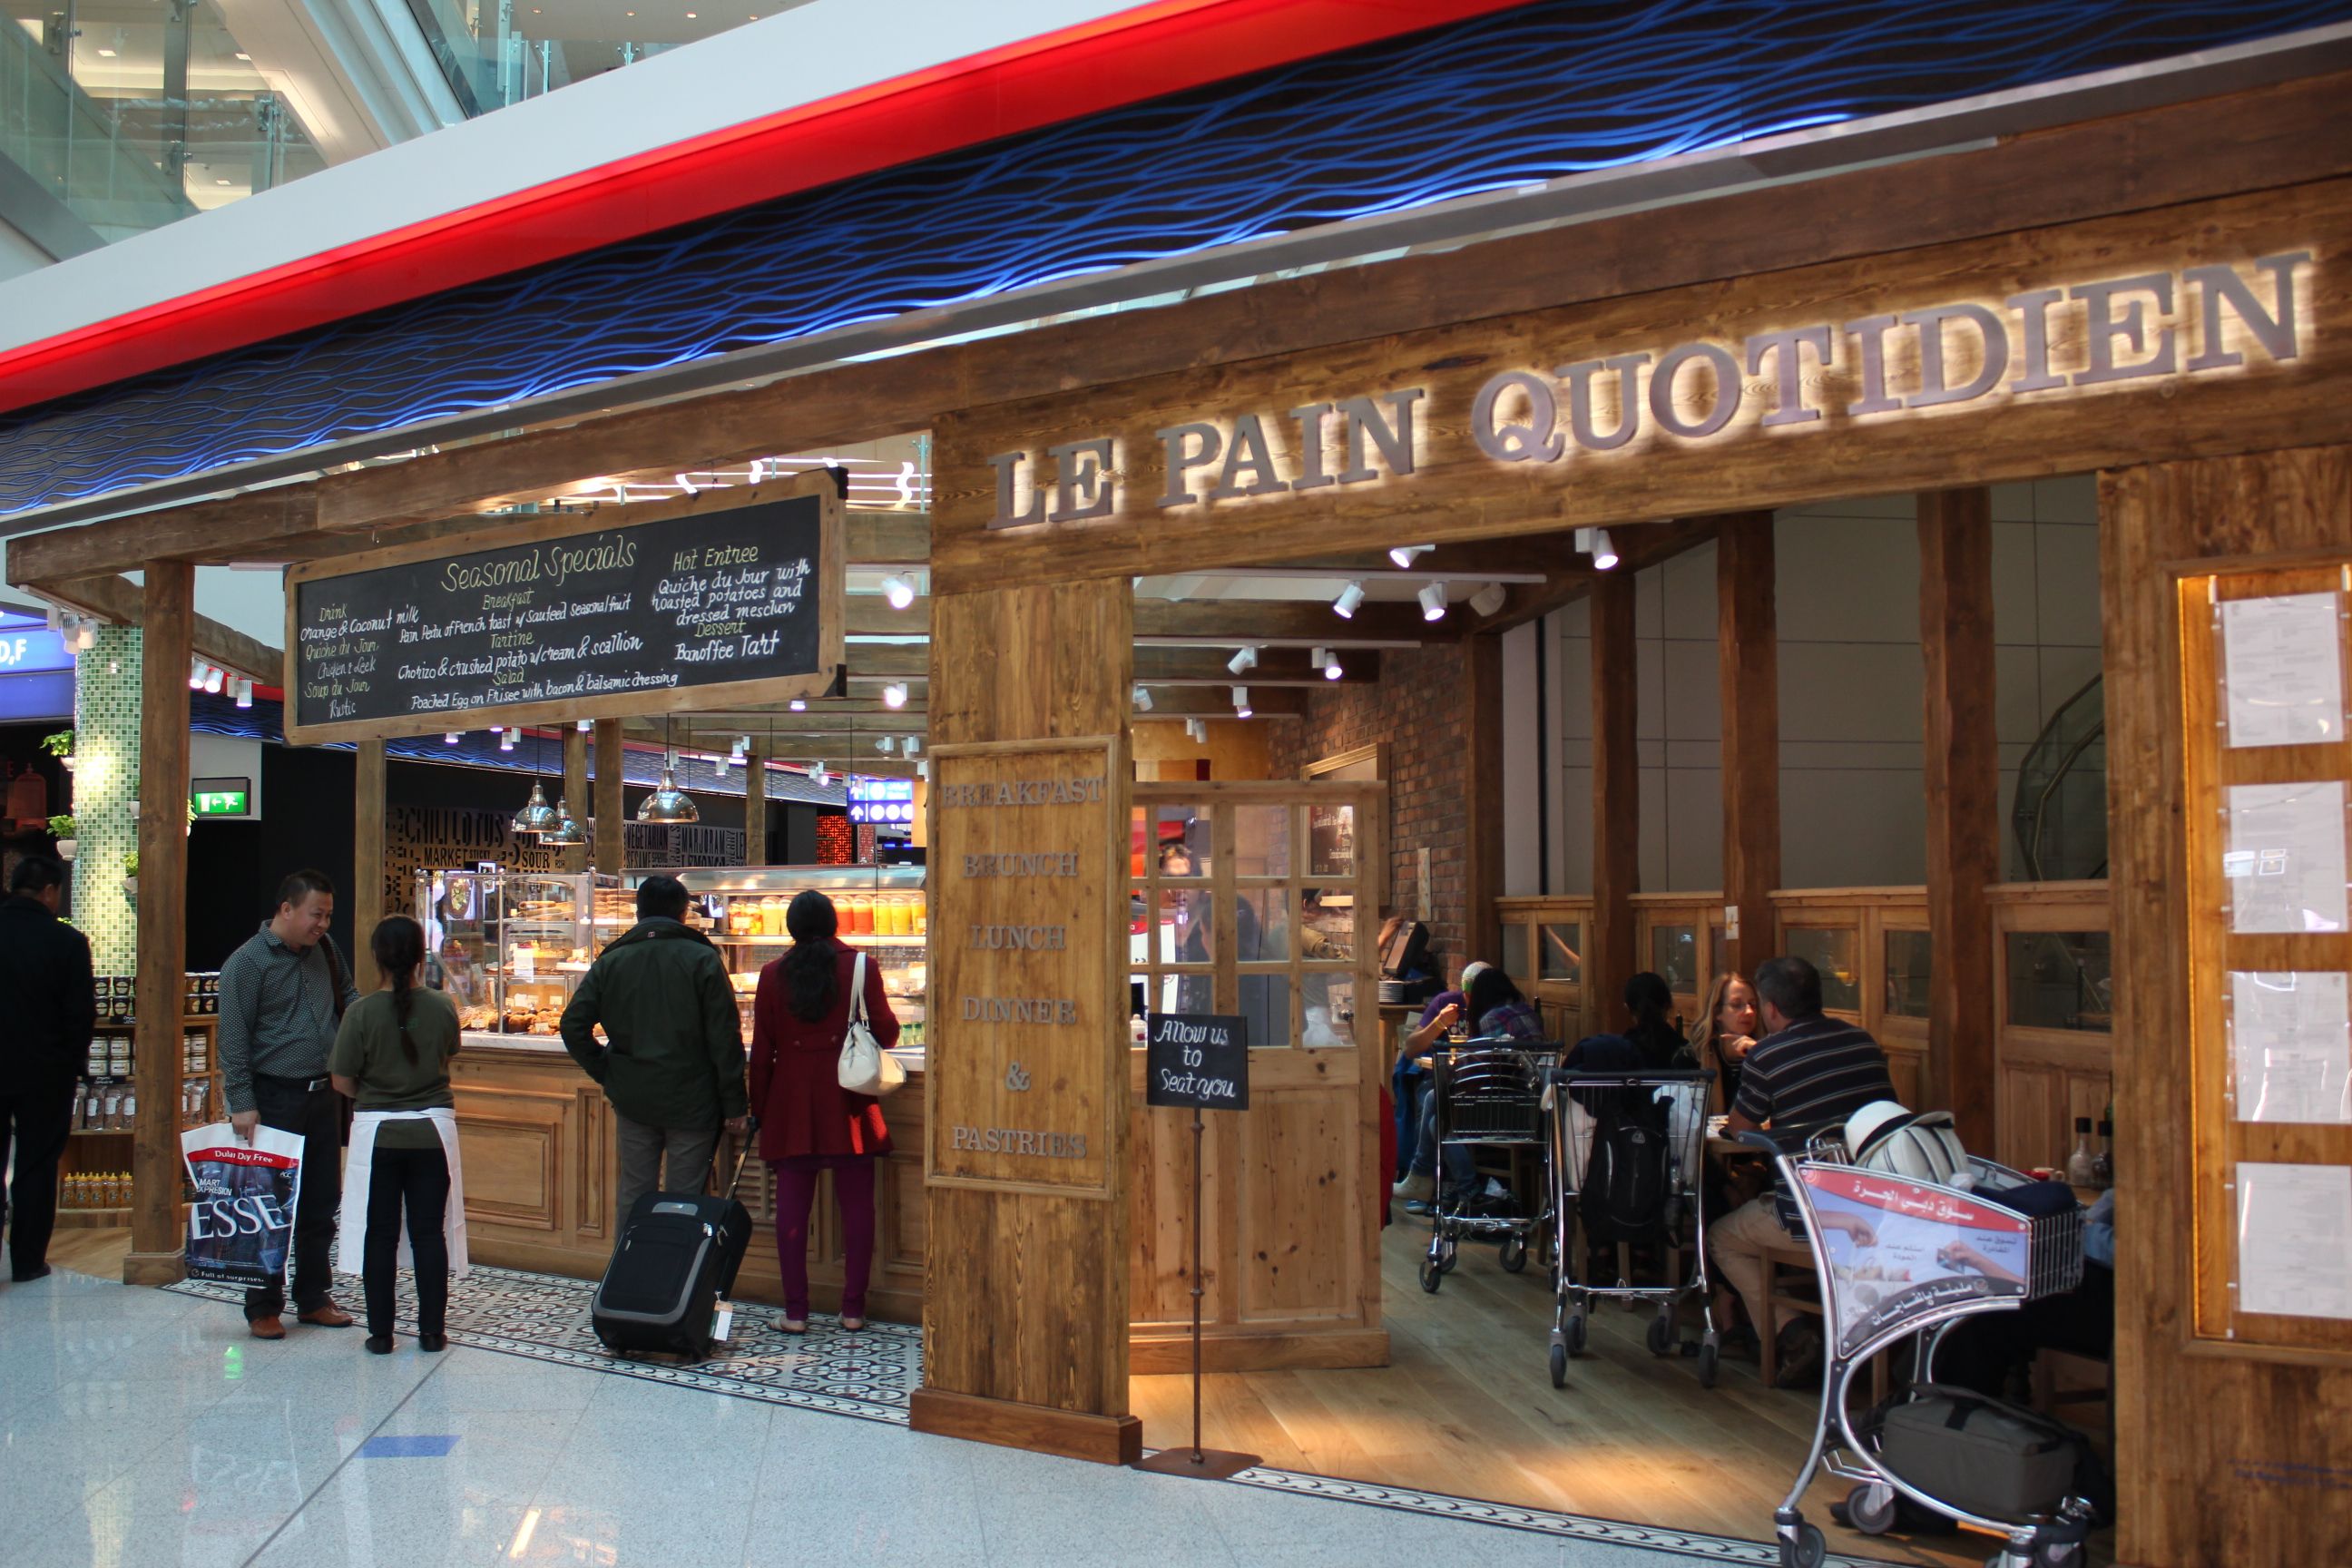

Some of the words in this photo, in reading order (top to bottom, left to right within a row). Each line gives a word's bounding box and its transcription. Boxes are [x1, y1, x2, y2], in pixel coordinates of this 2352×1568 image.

[986, 438, 1114, 530] LE
[1156, 387, 1426, 508] PAIN
[1470, 250, 2313, 465] QUOTIDIEN
[441, 548, 540, 592] Seasonal
[544, 534, 637, 587] Specials
[672, 548, 699, 573] Hot
[704, 544, 759, 567] Entree
[659, 574, 707, 595] Quiche
[712, 570, 732, 589] du
[735, 567, 769, 585] Jour
[776, 557, 811, 581] with
[482, 588, 535, 612] Breakfast
[652, 591, 701, 612] roasted
[706, 586, 766, 610] potatoes
[773, 577, 803, 598] and
[318, 603, 348, 622] Drink
[338, 620, 348, 636] &
[349, 609, 393, 633] Coconut
[396, 603, 419, 624] milk
[444, 621, 455, 637] of
[488, 612, 512, 631] toast
[526, 601, 567, 623] Sauteed
[676, 603, 730, 626] dressed
[735, 599, 795, 619] mesclun
[490, 629, 535, 649] Tartine
[694, 616, 747, 638] Dessert
[397, 661, 436, 680] Chorizo
[437, 656, 449, 677] &
[449, 655, 494, 677] crushed
[495, 650, 528, 675] potato
[577, 635, 591, 659] &
[591, 630, 644, 656] scallion
[674, 638, 734, 662] Banoffee
[741, 630, 780, 657] Tart
[354, 655, 377, 674] Leek
[492, 666, 524, 686] Salad
[304, 681, 329, 700] Soup
[411, 692, 449, 710] Poached
[451, 692, 469, 710] Egg
[470, 694, 485, 705] on
[486, 688, 520, 703] Frisee
[522, 681, 544, 699] with
[546, 680, 576, 696] bacon
[575, 674, 584, 691] &
[586, 669, 631, 691] balsamic
[632, 668, 679, 688] dressing
[329, 698, 357, 720] Rustic
[941, 777, 1106, 808] BREAKFAST
[626, 823, 669, 850] VEGETARIAN
[681, 827, 726, 854] MARJORAM
[424, 847, 468, 867] MARKET
[469, 849, 491, 860] STICKY
[521, 850, 551, 868] SOUR
[626, 851, 652, 868] SESAME
[963, 852, 1079, 877] BRUNCH
[971, 925, 1067, 951] LUNCH
[961, 997, 1077, 1024] DINNER
[1153, 1020, 1208, 1044] Allow
[1210, 1027, 1230, 1046] us
[1182, 1044, 1203, 1067] to
[1005, 1060, 1032, 1092] &
[1161, 1068, 1197, 1094] Seat
[1196, 1077, 1237, 1102] you
[951, 1125, 1088, 1160] PASTRIES
[253, 1153, 273, 1164] Free
[198, 1178, 220, 1187] MART
[191, 1194, 293, 1240] ESSE
